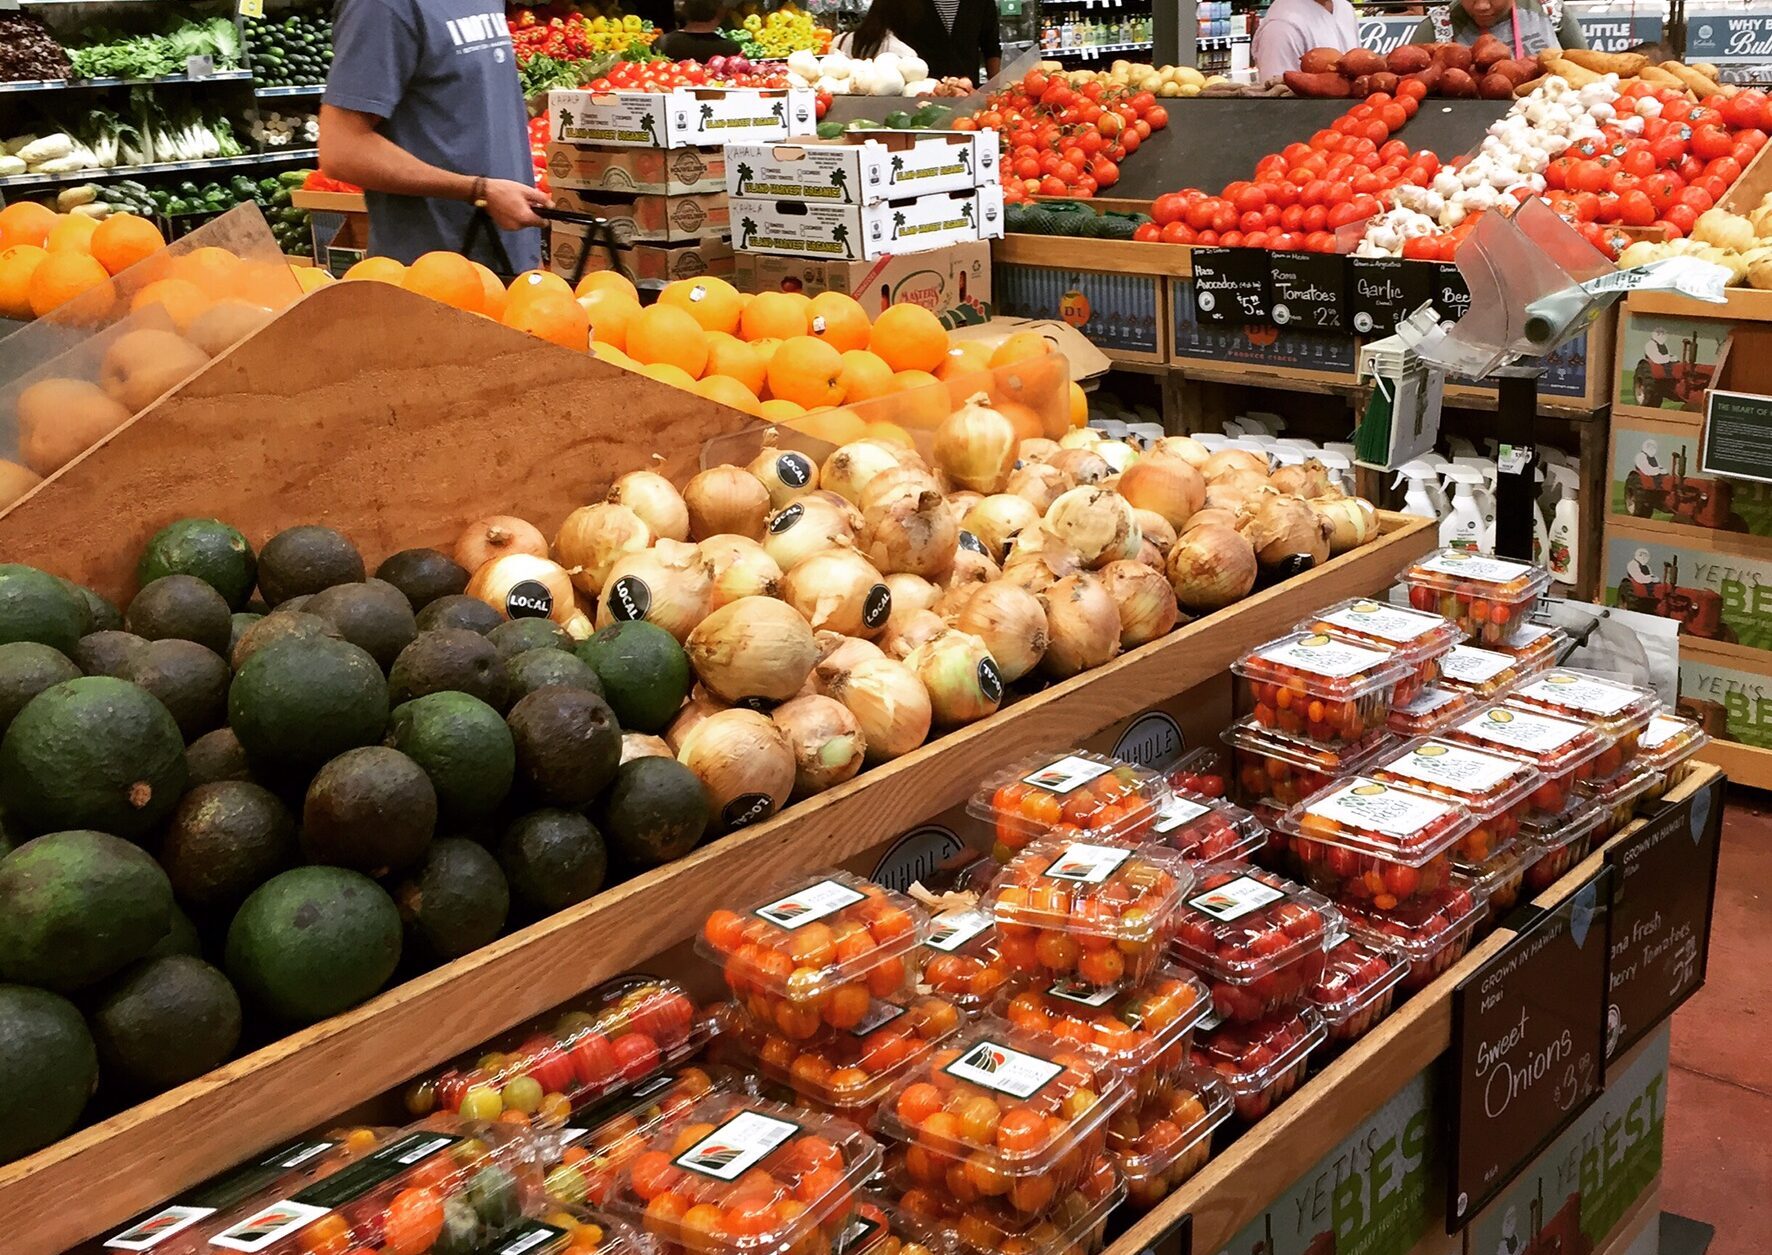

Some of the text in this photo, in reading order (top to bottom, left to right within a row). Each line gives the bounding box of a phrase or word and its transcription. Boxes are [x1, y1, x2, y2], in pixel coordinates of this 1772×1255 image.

[1582, 23, 1630, 36] LITTLE
[1728, 20, 1760, 30] WHY
[1194, 265, 1214, 277] Hass
[1196, 273, 1238, 290] Avocados
[1271, 269, 1297, 280] Roma
[1275, 283, 1336, 302] Tomatoes
[1357, 278, 1404, 300] Garlic
[781, 456, 805, 484] LOCAL
[771, 507, 801, 531] LOCAL
[1694, 562, 1762, 590] YETI'S
[510, 595, 548, 612] LOCAL
[616, 581, 638, 620] LOCAL
[867, 593, 890, 623] LOCAL
[1698, 673, 1764, 703] YETI'S
[1481, 955, 1518, 994] GROWN
[1518, 946, 1530, 966] IN
[1476, 1006, 1530, 1077] Sweet
[1485, 1029, 1572, 1118] Onions
[1580, 1073, 1664, 1198] BEST
[1296, 1128, 1377, 1234] YETI'S
